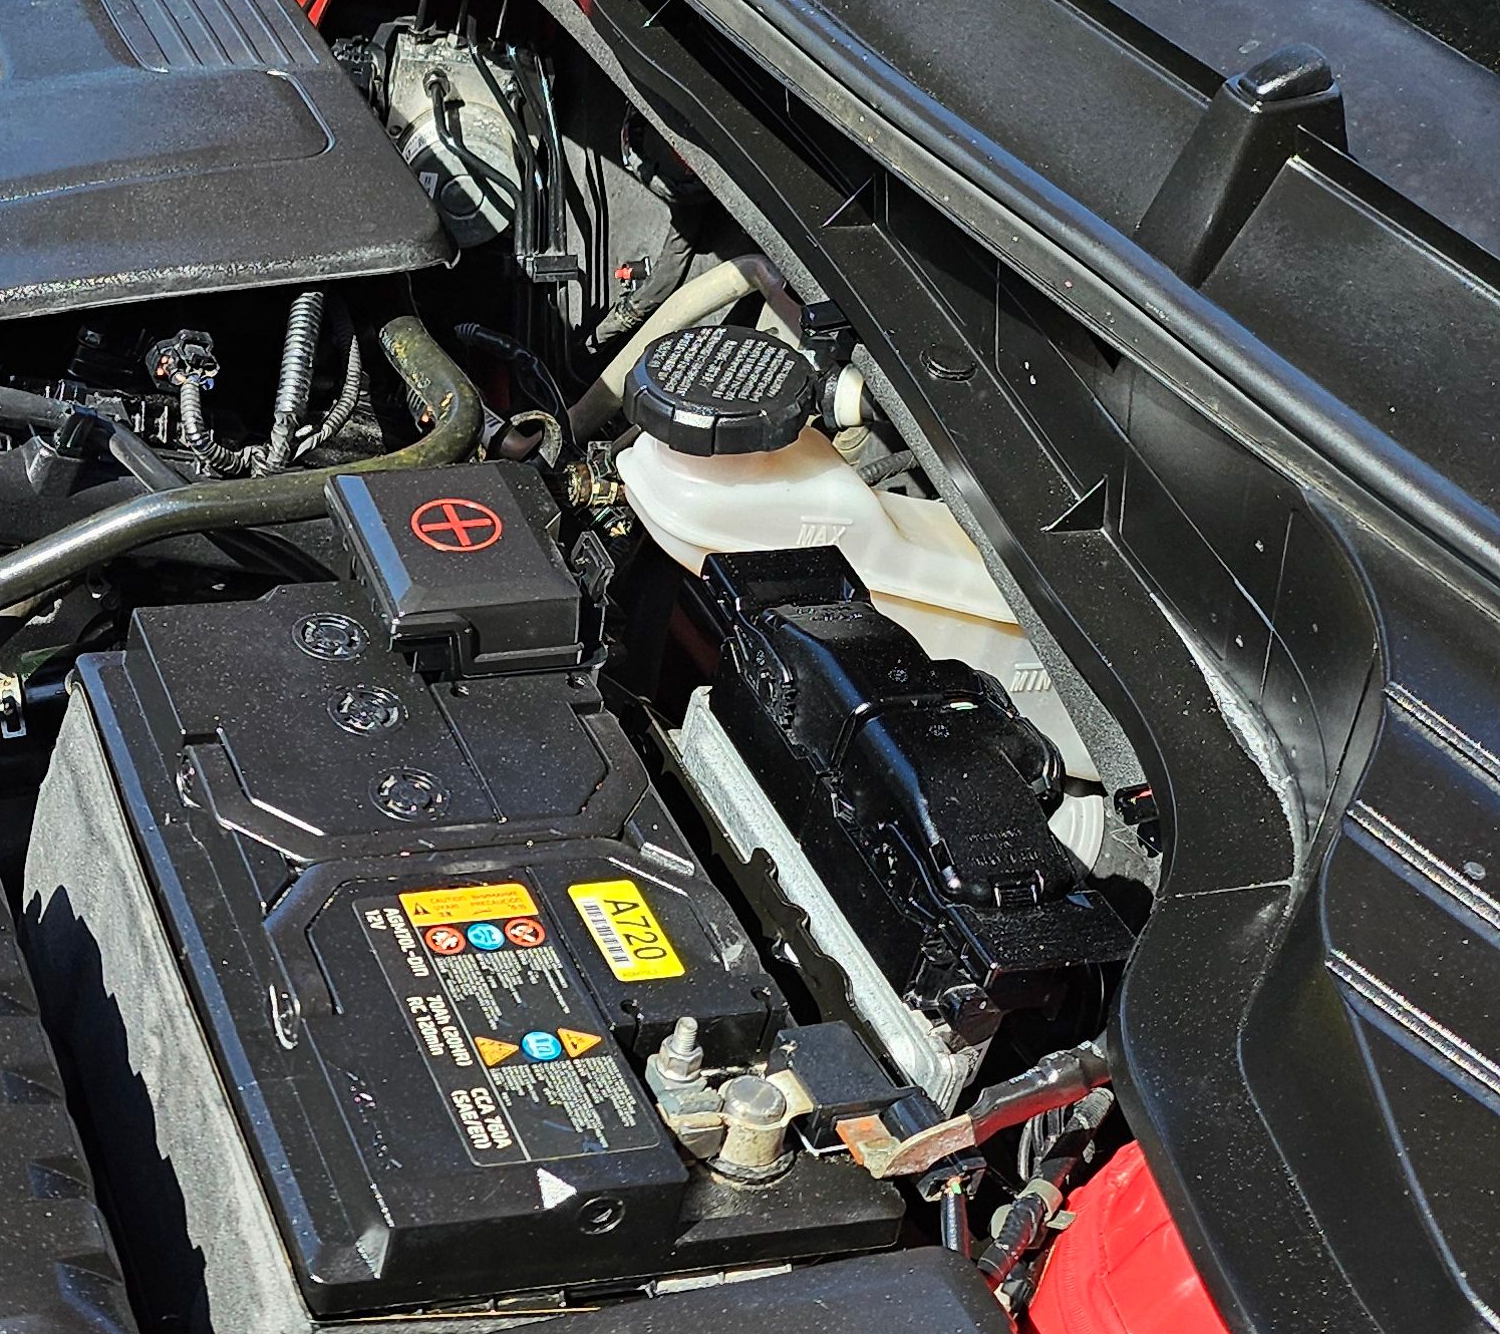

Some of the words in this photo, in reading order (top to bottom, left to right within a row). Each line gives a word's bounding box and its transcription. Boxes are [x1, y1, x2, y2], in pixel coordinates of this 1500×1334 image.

[796, 523, 846, 547] MAX
[1010, 669, 1052, 692] MIN
[603, 899, 667, 960] A720
[365, 909, 387, 930] 12V
[406, 996, 423, 1014] RC
[415, 1015, 444, 1056] 120min
[426, 994, 451, 1025] 70Ah
[441, 1024, 473, 1067] (20HR)
[470, 1087, 490, 1115] CCA
[485, 1115, 513, 1149] 760A
